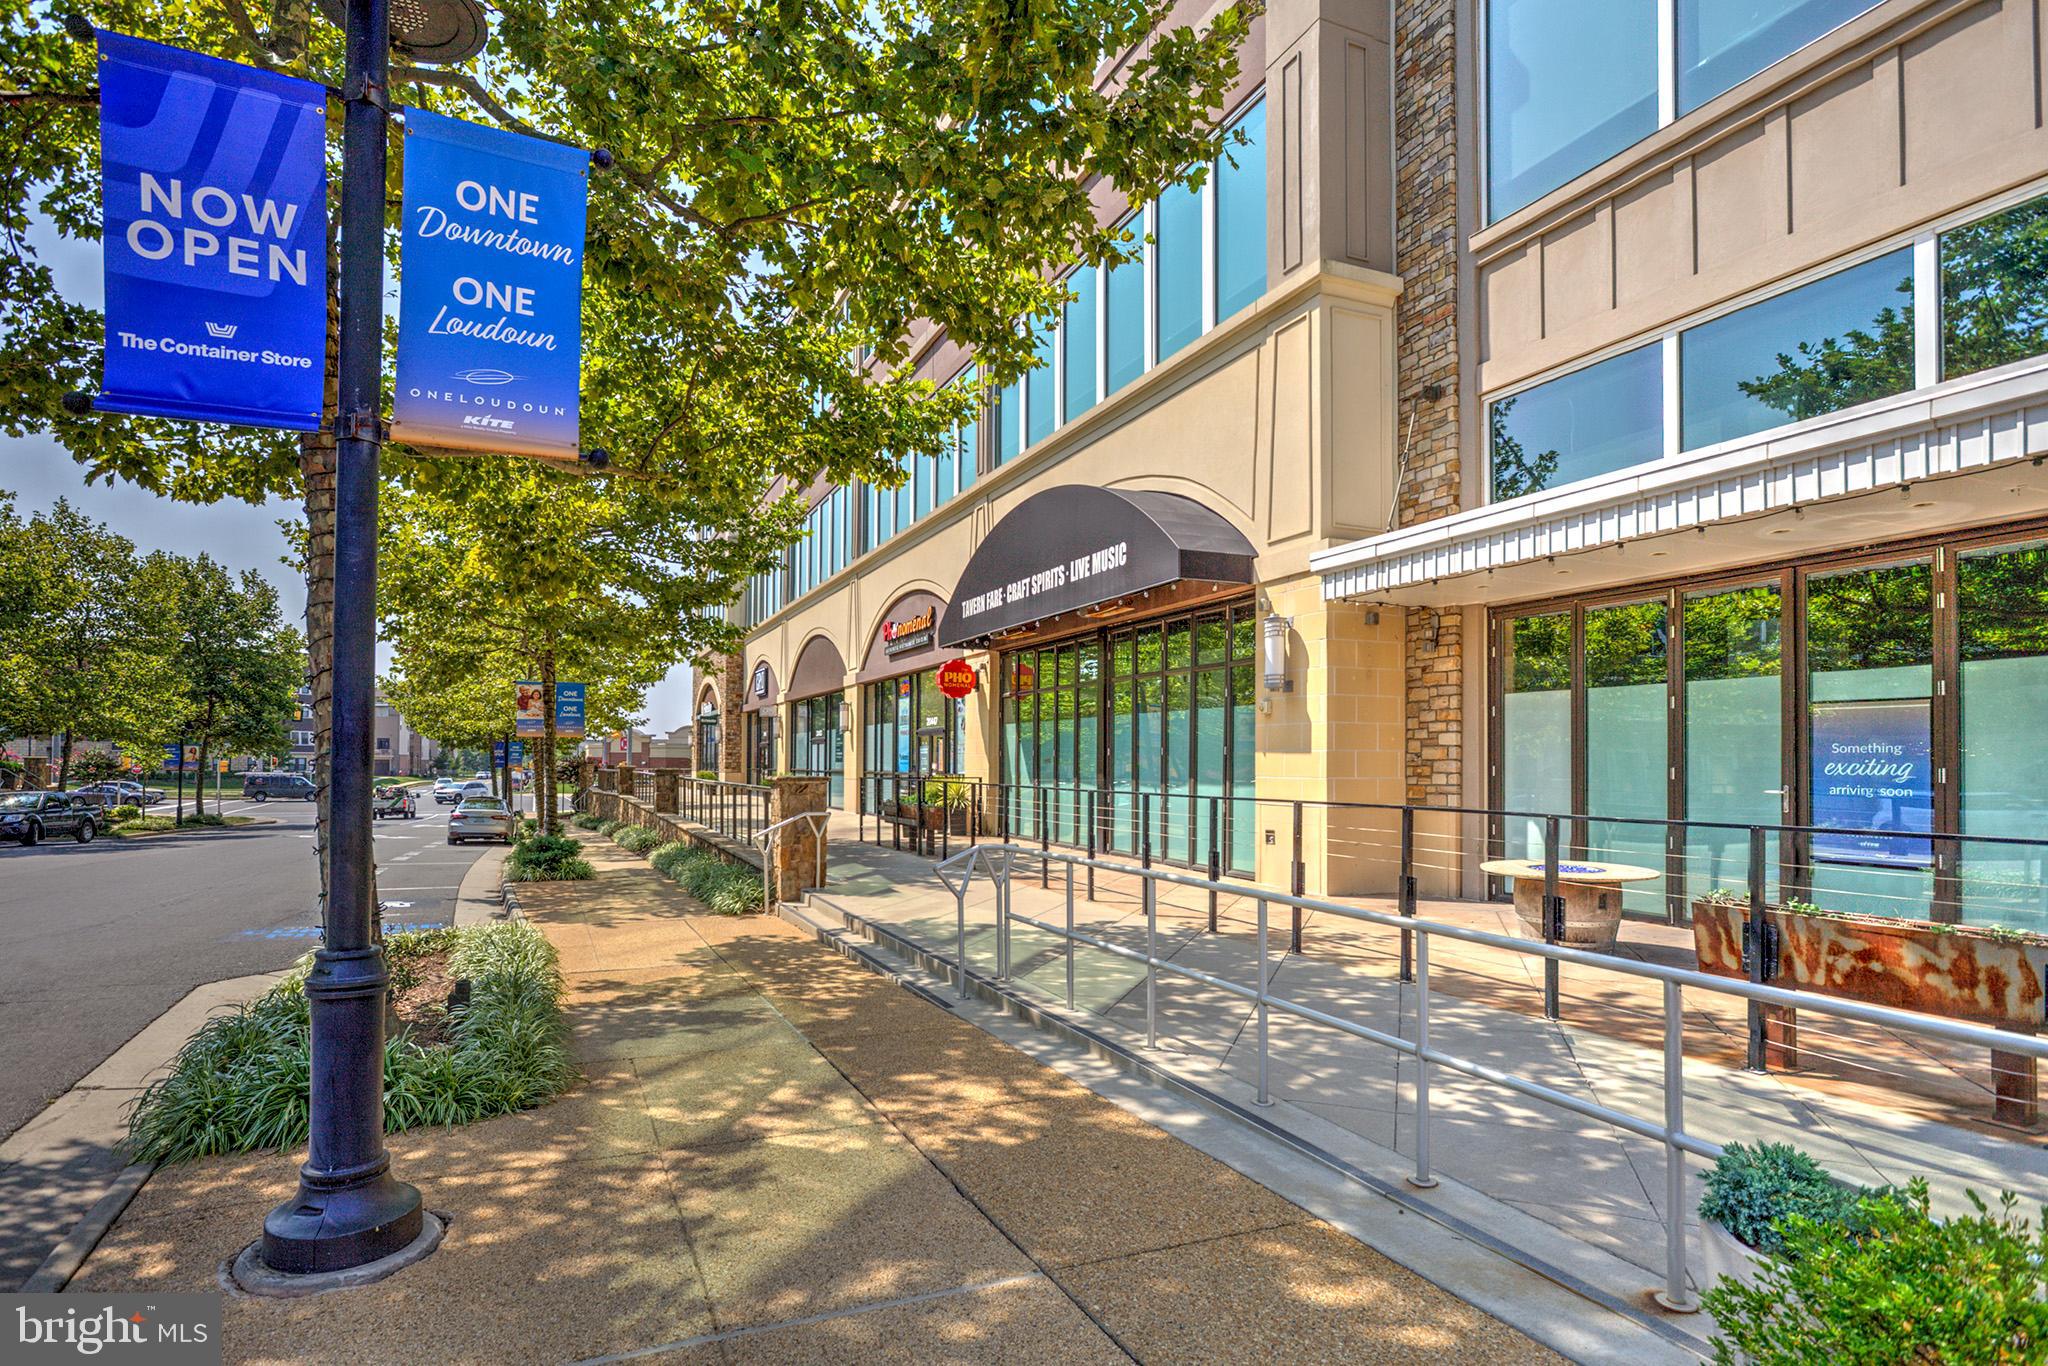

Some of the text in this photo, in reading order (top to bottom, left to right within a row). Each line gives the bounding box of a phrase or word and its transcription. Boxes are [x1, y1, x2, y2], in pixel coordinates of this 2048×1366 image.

[140, 172, 297, 240] NOW
[455, 180, 539, 225] ONE
[126, 218, 308, 286] OPEN
[416, 205, 575, 266] Downtown
[452, 276, 535, 317] ONE
[428, 304, 558, 352] Loudoun
[118, 331, 312, 369] The Container Store
[410, 388, 565, 416] ONELOUDOUN
[961, 541, 1127, 619] TAVERN FARE CRAFT SPIRITS LIVE MUSIC
[1824, 758, 1916, 783] exciting
[1831, 743, 1902, 756] Something
[1829, 785, 1913, 798] arriving soon
